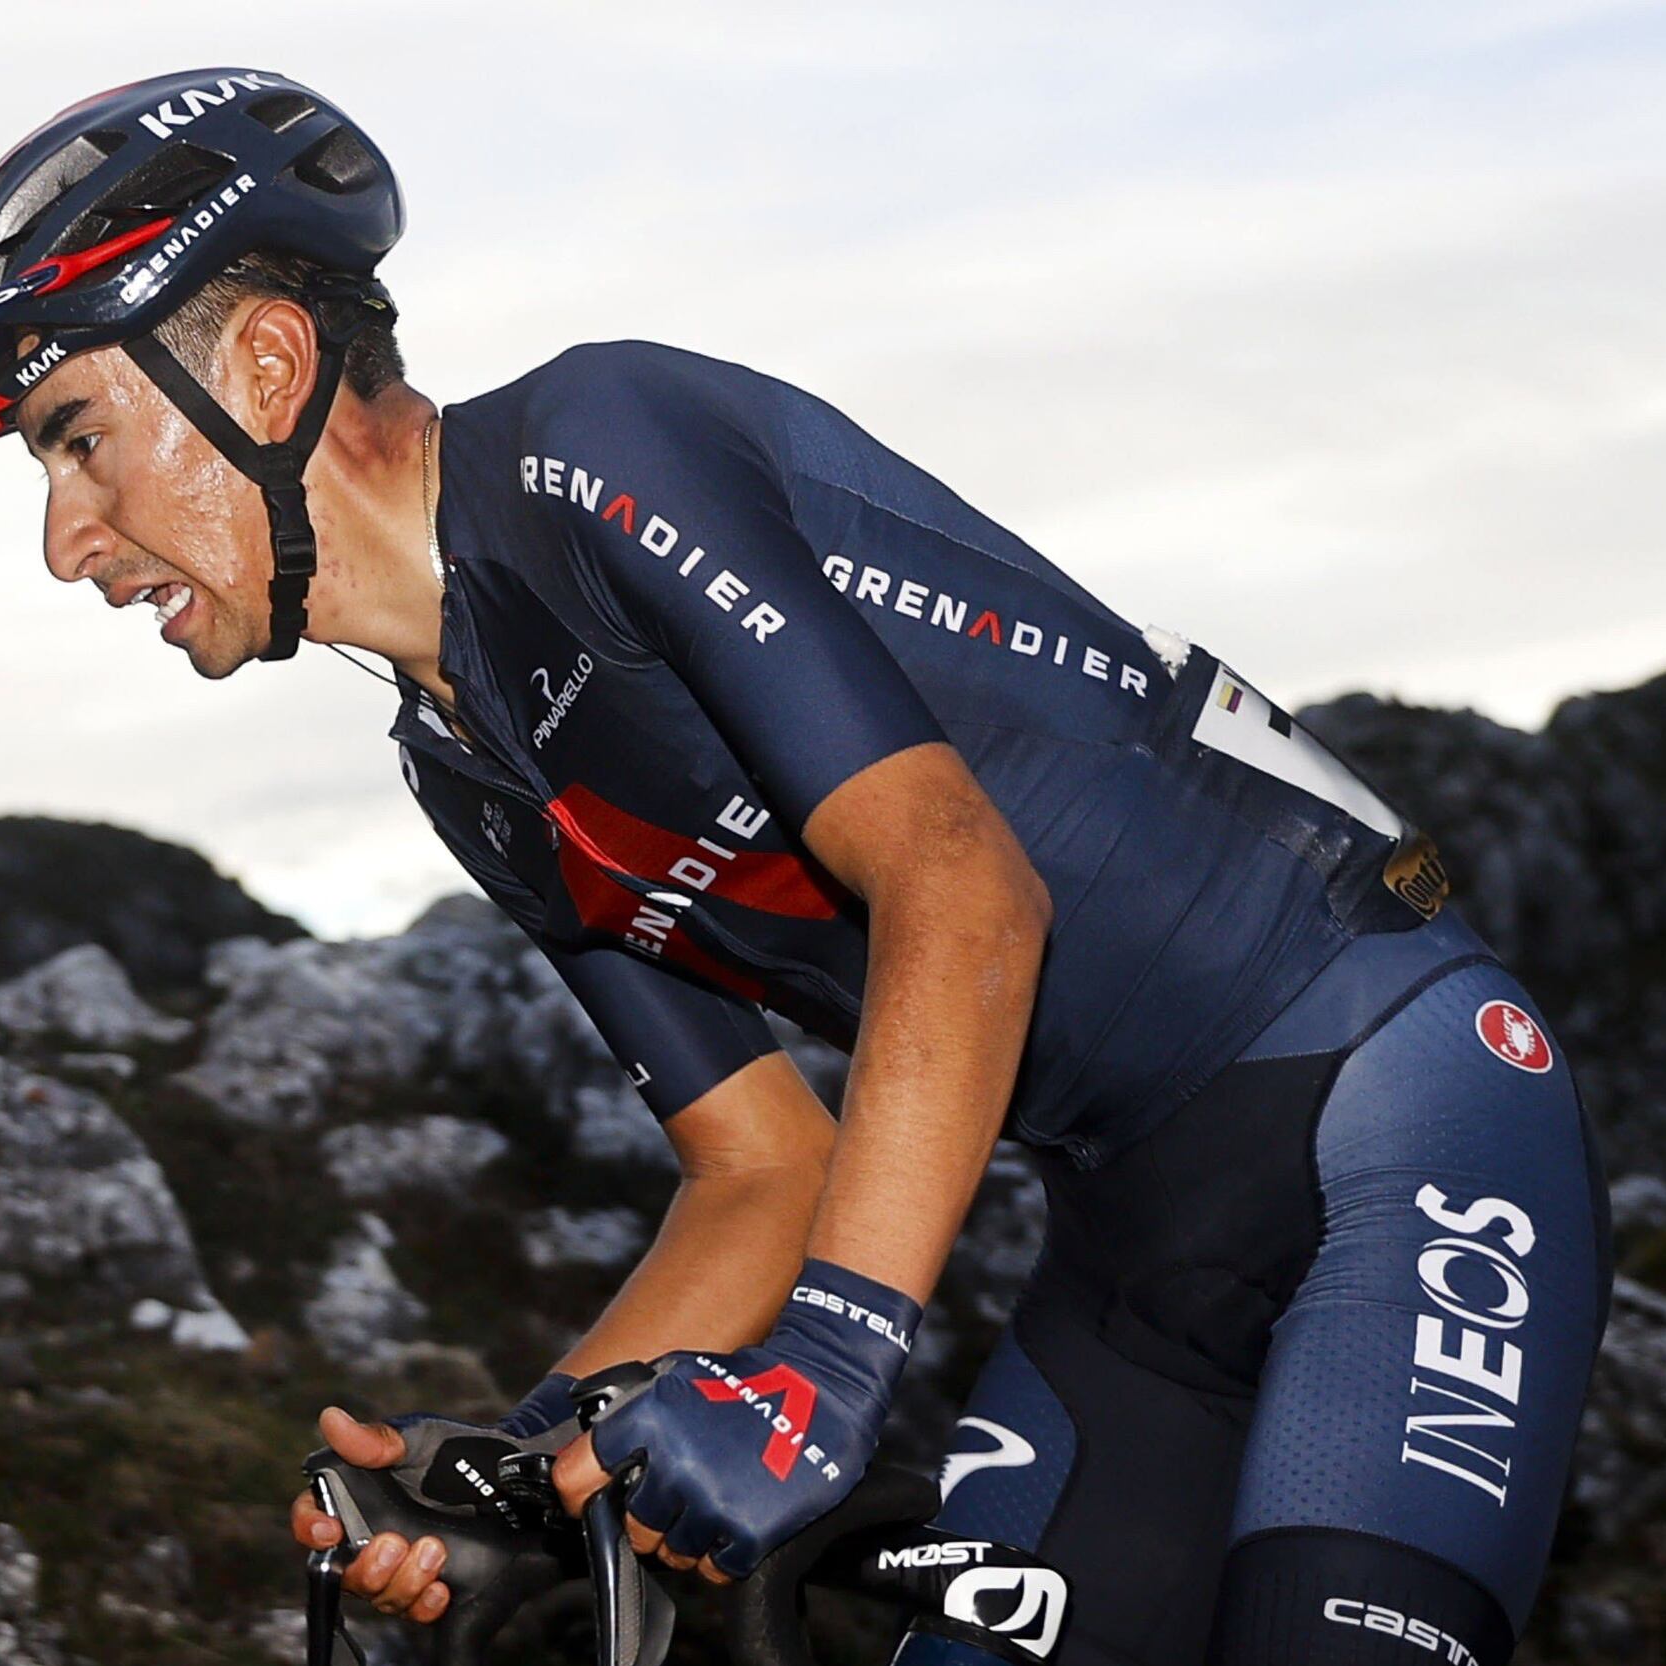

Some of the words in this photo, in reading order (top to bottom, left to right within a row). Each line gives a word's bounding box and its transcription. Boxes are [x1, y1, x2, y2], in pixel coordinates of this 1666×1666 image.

[138, 72, 277, 140] KASK
[120, 173, 257, 305] GRENADIER
[16, 342, 67, 387] KASK
[520, 455, 787, 644] RENADIER
[821, 555, 1149, 699] GRENADIER
[533, 652, 594, 750] PINARELLO
[1402, 1182, 1536, 1508] INEOS
[696, 1355, 841, 1483] GRENADIER
